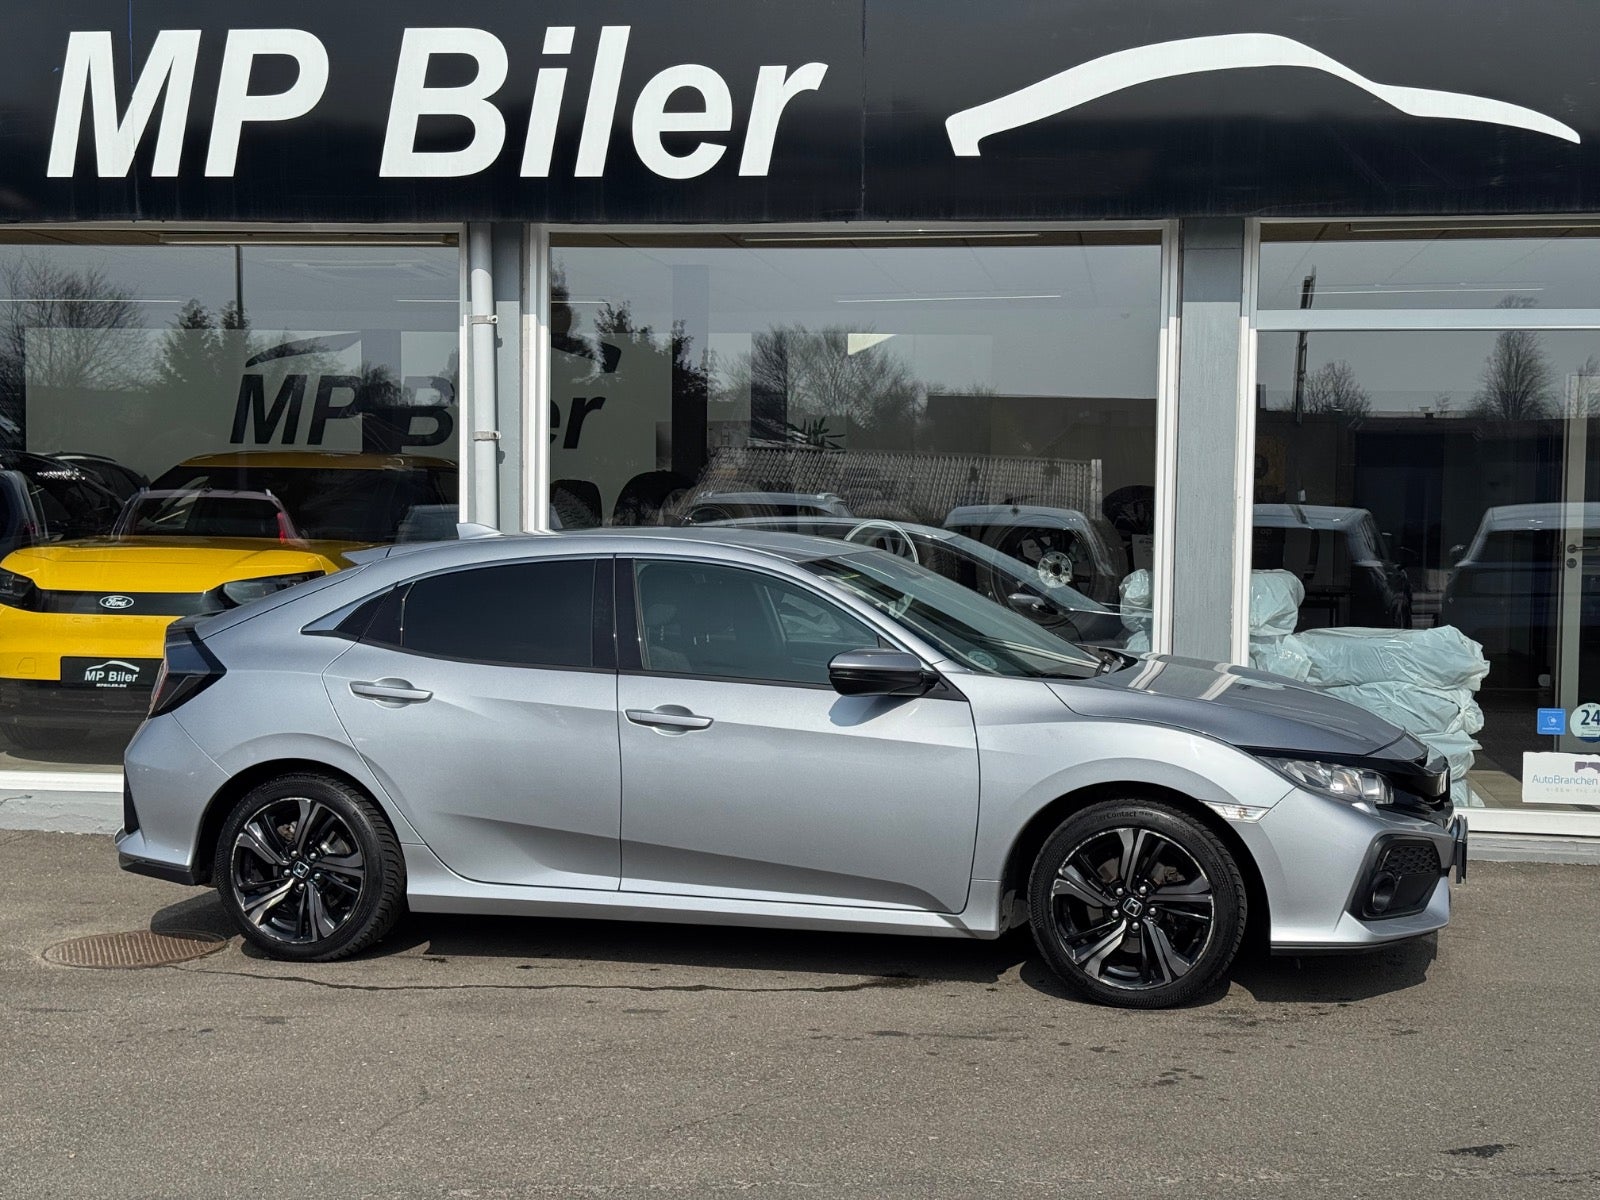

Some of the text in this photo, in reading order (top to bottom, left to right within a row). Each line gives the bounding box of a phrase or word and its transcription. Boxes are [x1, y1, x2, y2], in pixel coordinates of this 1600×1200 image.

[47, 25, 828, 180] MP Biler
[230, 373, 362, 446] MP
[105, 597, 128, 607] Ford
[84, 670, 138, 682] MP Biler
[1580, 709, 1600, 726] 24
[1532, 774, 1598, 785] AutoBranchen
